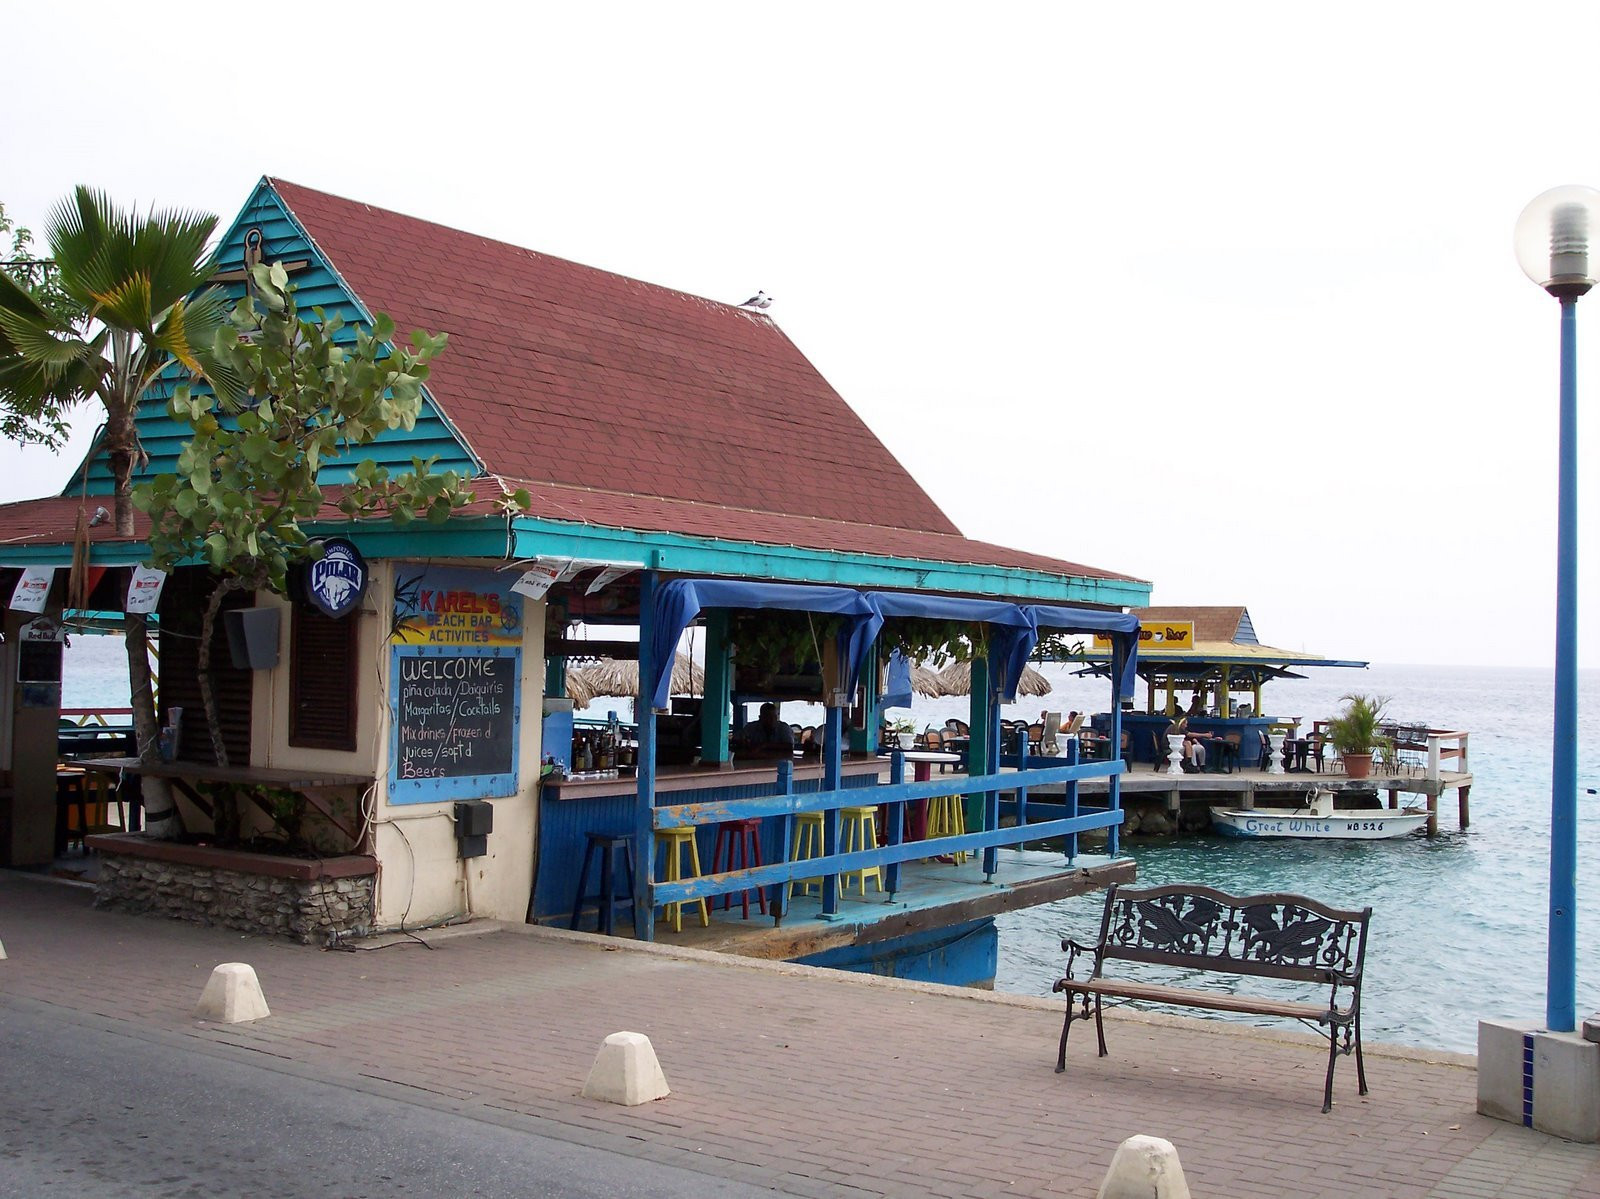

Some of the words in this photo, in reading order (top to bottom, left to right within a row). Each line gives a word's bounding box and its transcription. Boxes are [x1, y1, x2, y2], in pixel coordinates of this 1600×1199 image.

[315, 561, 359, 587] POLAR
[420, 590, 500, 613] KAREL'S
[426, 613, 465, 627] BEACH
[470, 615, 493, 628] BAR
[28, 631, 42, 640] Red
[429, 629, 489, 642] ACTIVITIES
[402, 658, 496, 681] WELCOME
[1246, 819, 1283, 832] Great
[1289, 821, 1330, 833] White
[1362, 822, 1384, 832] 526
